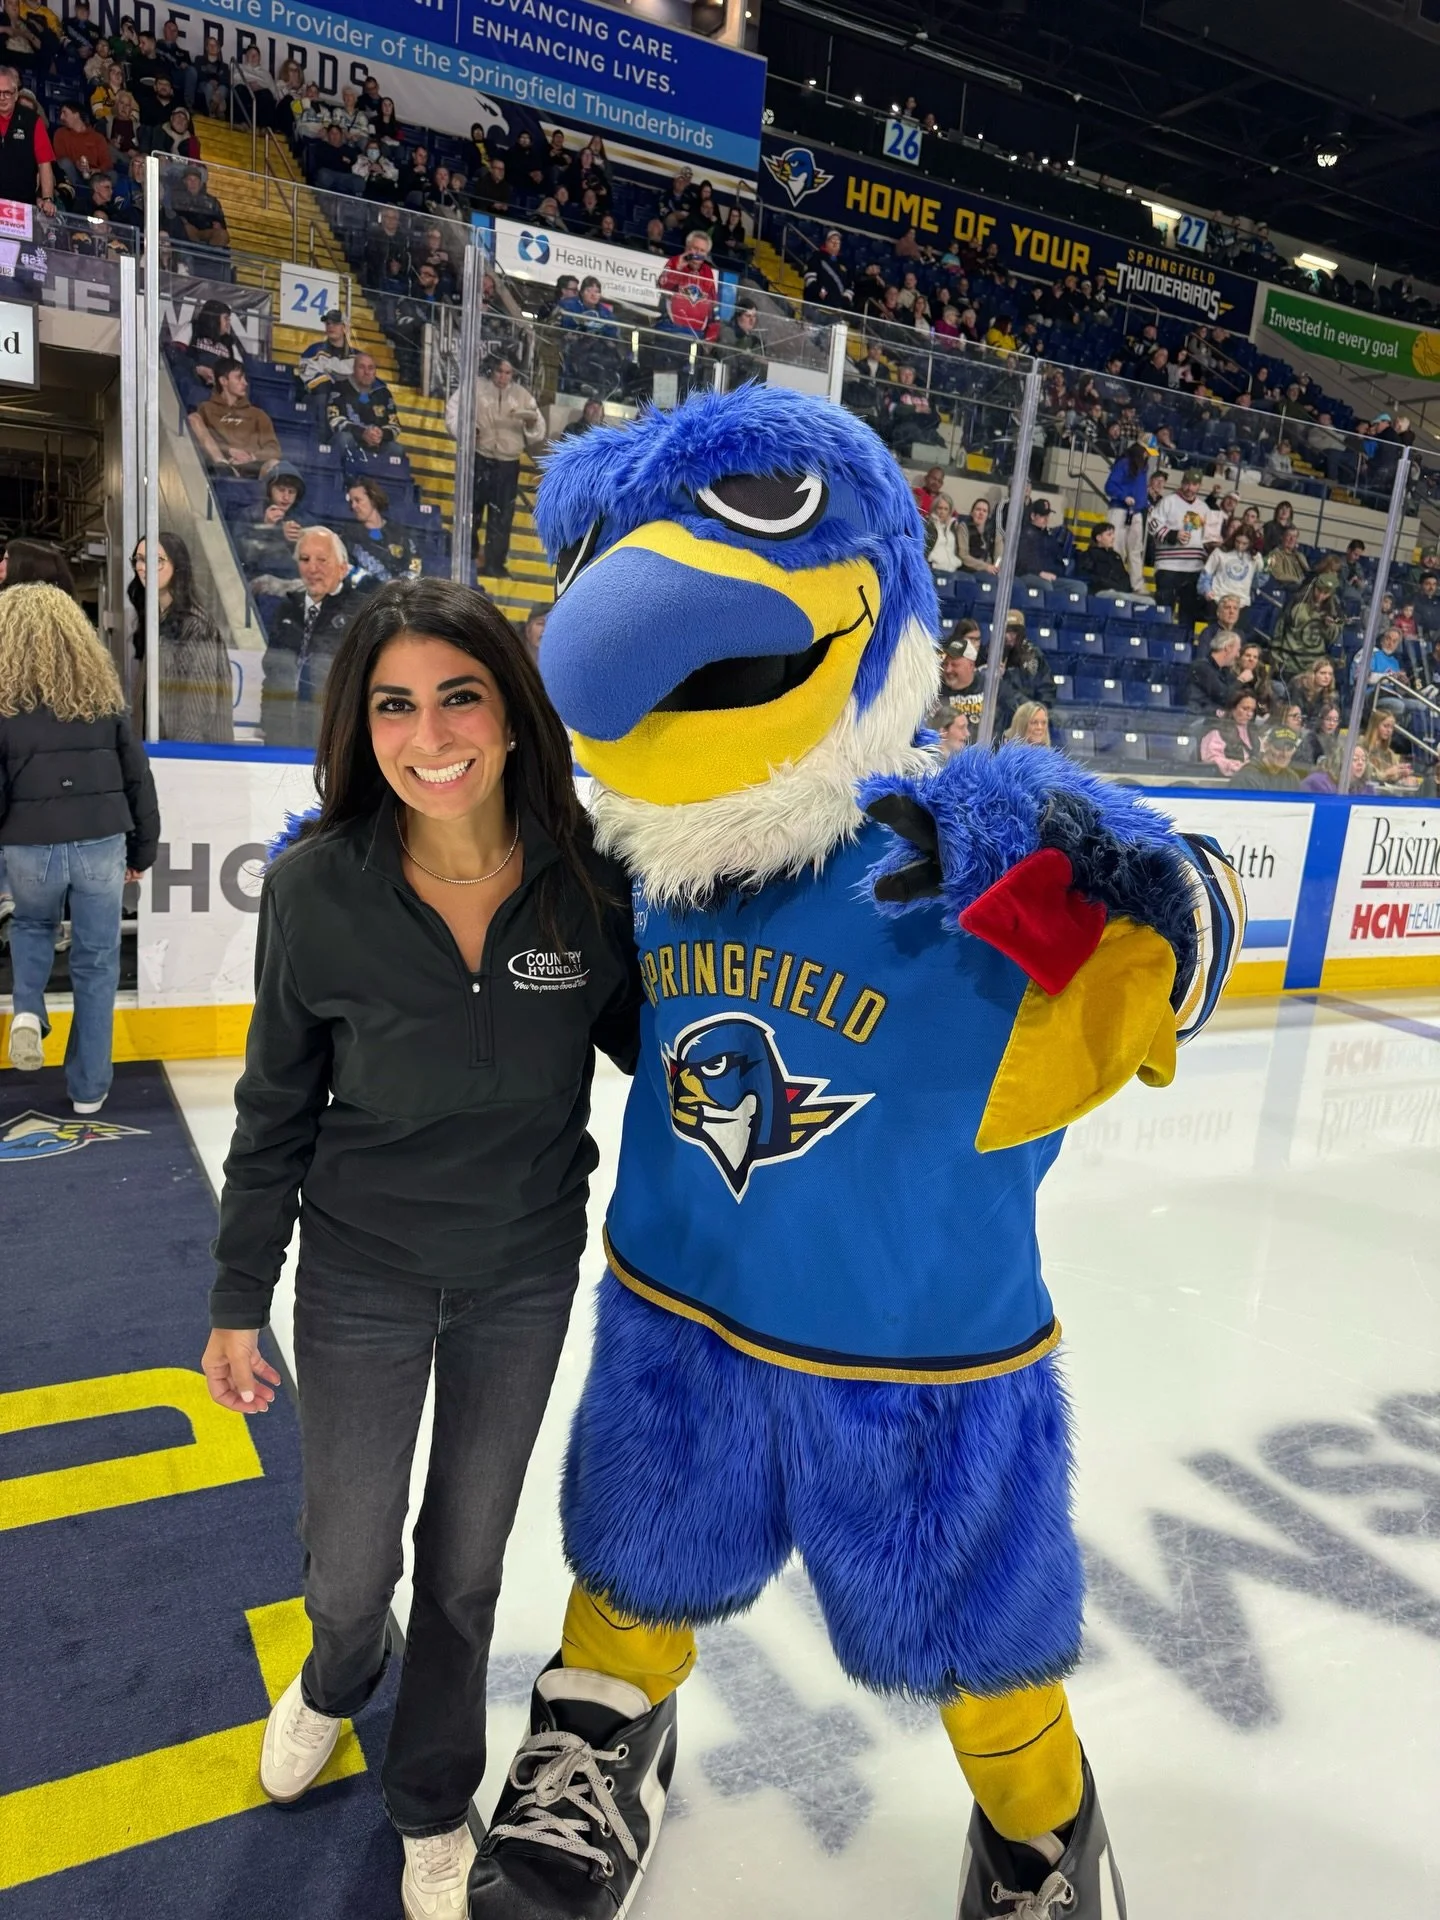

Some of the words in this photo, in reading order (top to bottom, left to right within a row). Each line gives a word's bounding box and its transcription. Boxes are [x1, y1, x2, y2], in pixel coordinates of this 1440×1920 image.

[484, 0, 608, 40] VANCING
[617, 29, 678, 64] CARE.
[270, 1, 374, 49] Provider
[381, 37, 407, 60] of
[412, 44, 451, 73] the
[458, 56, 576, 109] Springfield
[582, 92, 714, 149] Thunderbirds
[472, 15, 605, 72] ENHANCING
[613, 60, 676, 95] LIVES.
[888, 123, 919, 160] 26
[845, 175, 941, 233] HOME
[953, 207, 997, 245] OF
[1011, 223, 1091, 275] YOUR
[1178, 215, 1206, 247] 27
[555, 247, 601, 272] Health
[605, 258, 638, 280] New
[1127, 249, 1216, 286] SPRINGFIELD
[291, 283, 330, 316] 24
[1116, 262, 1221, 321] THUNDERBIRDS
[1268, 307, 1321, 339] Invested
[1323, 322, 1336, 342] in
[1337, 330, 1371, 355] every
[1372, 340, 1399, 358] goal
[1350, 903, 1409, 939] HCN
